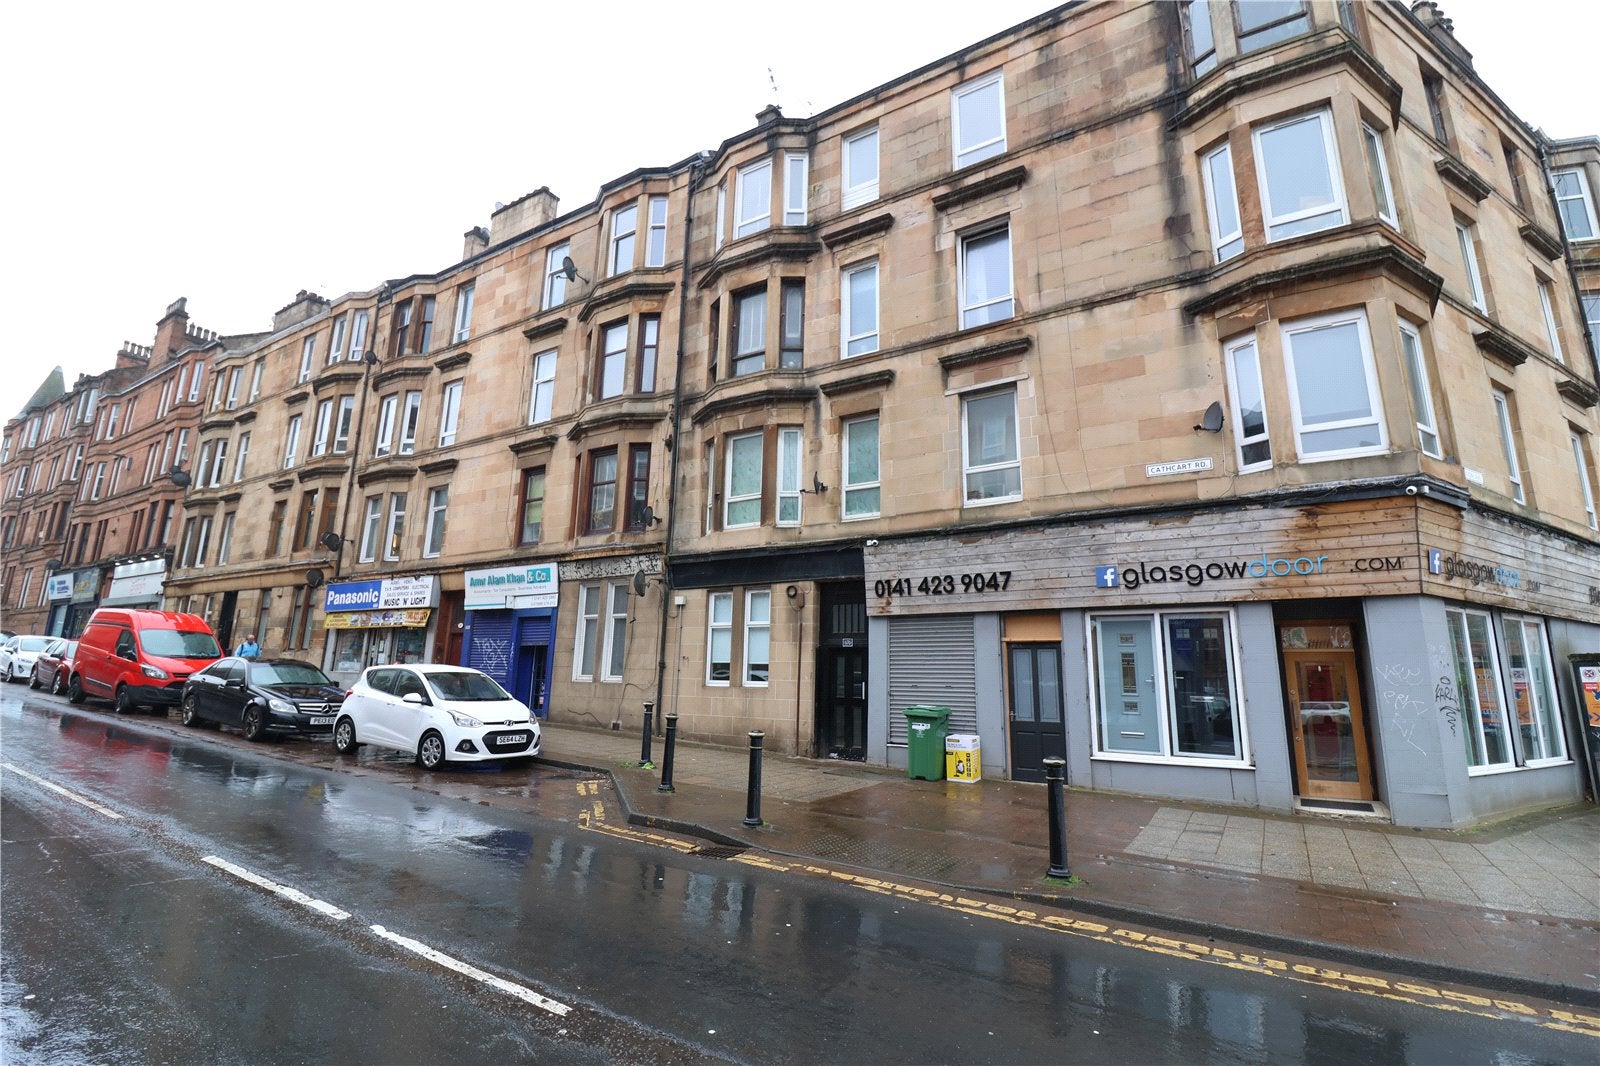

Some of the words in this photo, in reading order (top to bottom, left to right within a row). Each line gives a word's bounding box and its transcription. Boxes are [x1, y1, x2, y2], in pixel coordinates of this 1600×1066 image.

[1150, 462, 1192, 473] CATHCART
[487, 575, 506, 585] Alam
[506, 573, 526, 584] Khan
[527, 571, 534, 582] &
[535, 570, 550, 581] Co.
[1122, 553, 1329, 589] glasgowdoor
[874, 577, 912, 599] 0141
[917, 575, 955, 596] 423
[961, 571, 1012, 594] 9047
[327, 588, 379, 605] Panasonic
[384, 598, 400, 606] MUSIC
[410, 597, 426, 605] LIGHT
